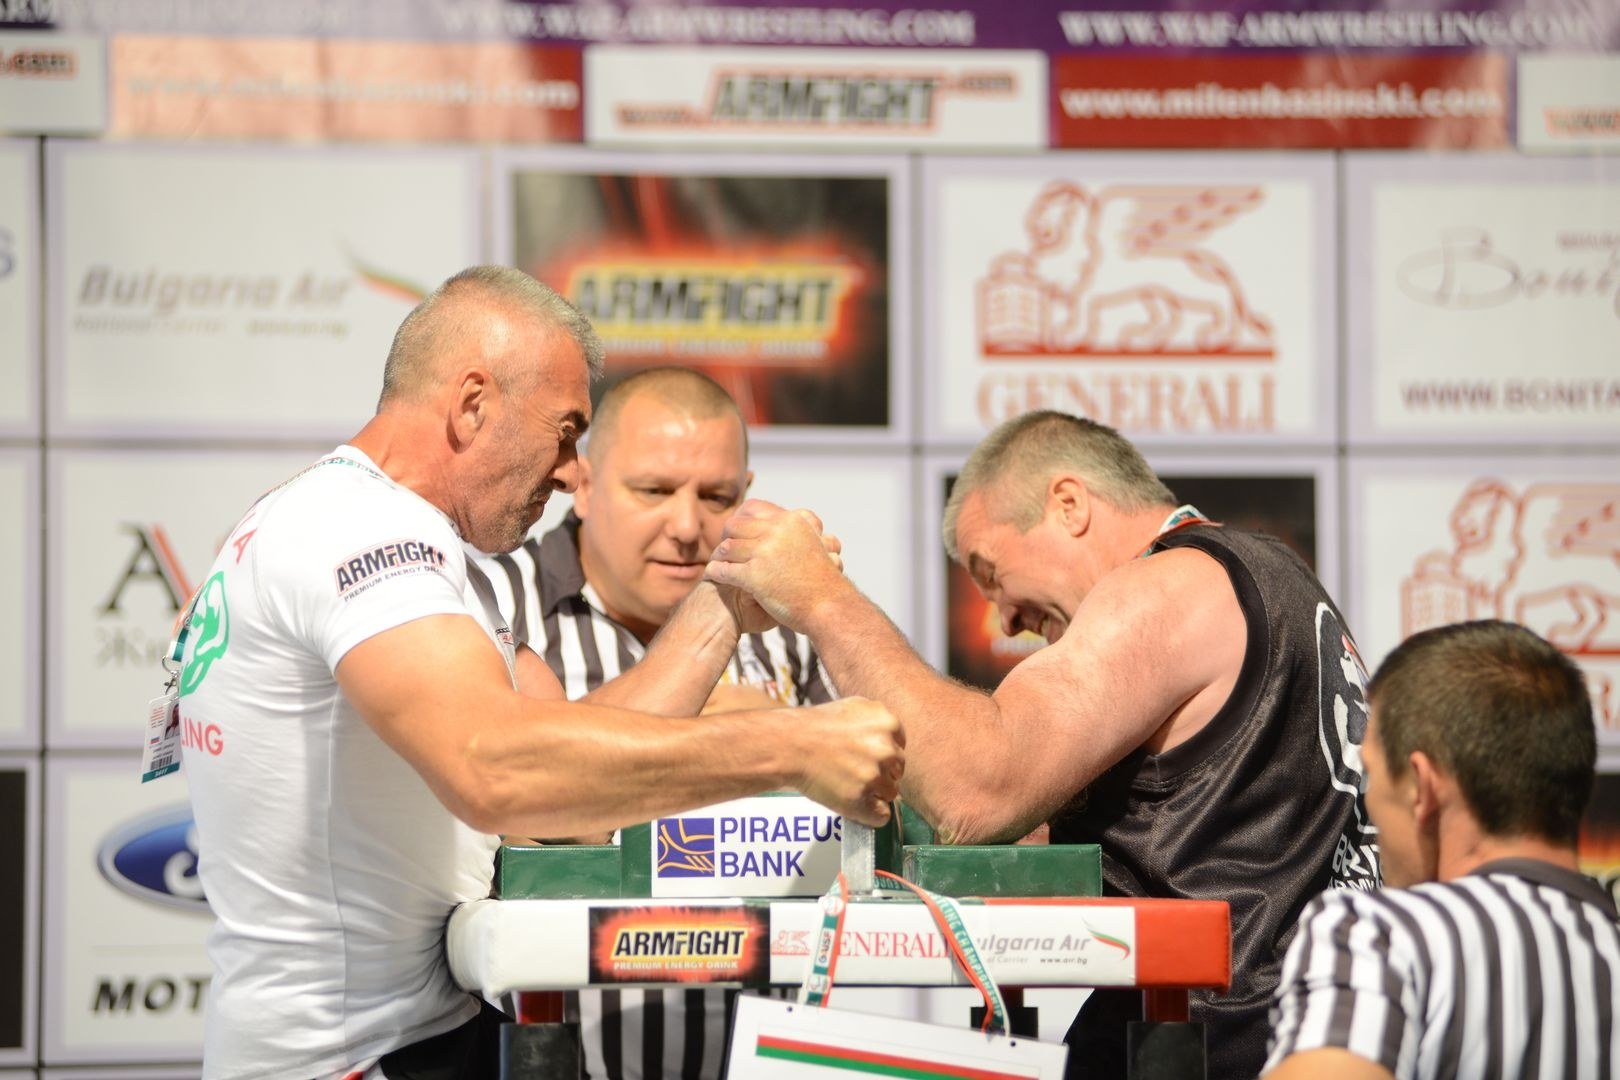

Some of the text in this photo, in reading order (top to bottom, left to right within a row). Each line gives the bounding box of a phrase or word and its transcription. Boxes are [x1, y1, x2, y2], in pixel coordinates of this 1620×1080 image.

[574, 275, 838, 326] ARMFIGHT
[720, 850, 805, 878] BANK
[615, 930, 745, 957] ARMFIGHT
[1060, 934, 1091, 951] Air
[614, 961, 738, 971] PREMIUM ENERGY DRINK
[1040, 957, 1088, 966] www.air.bg
